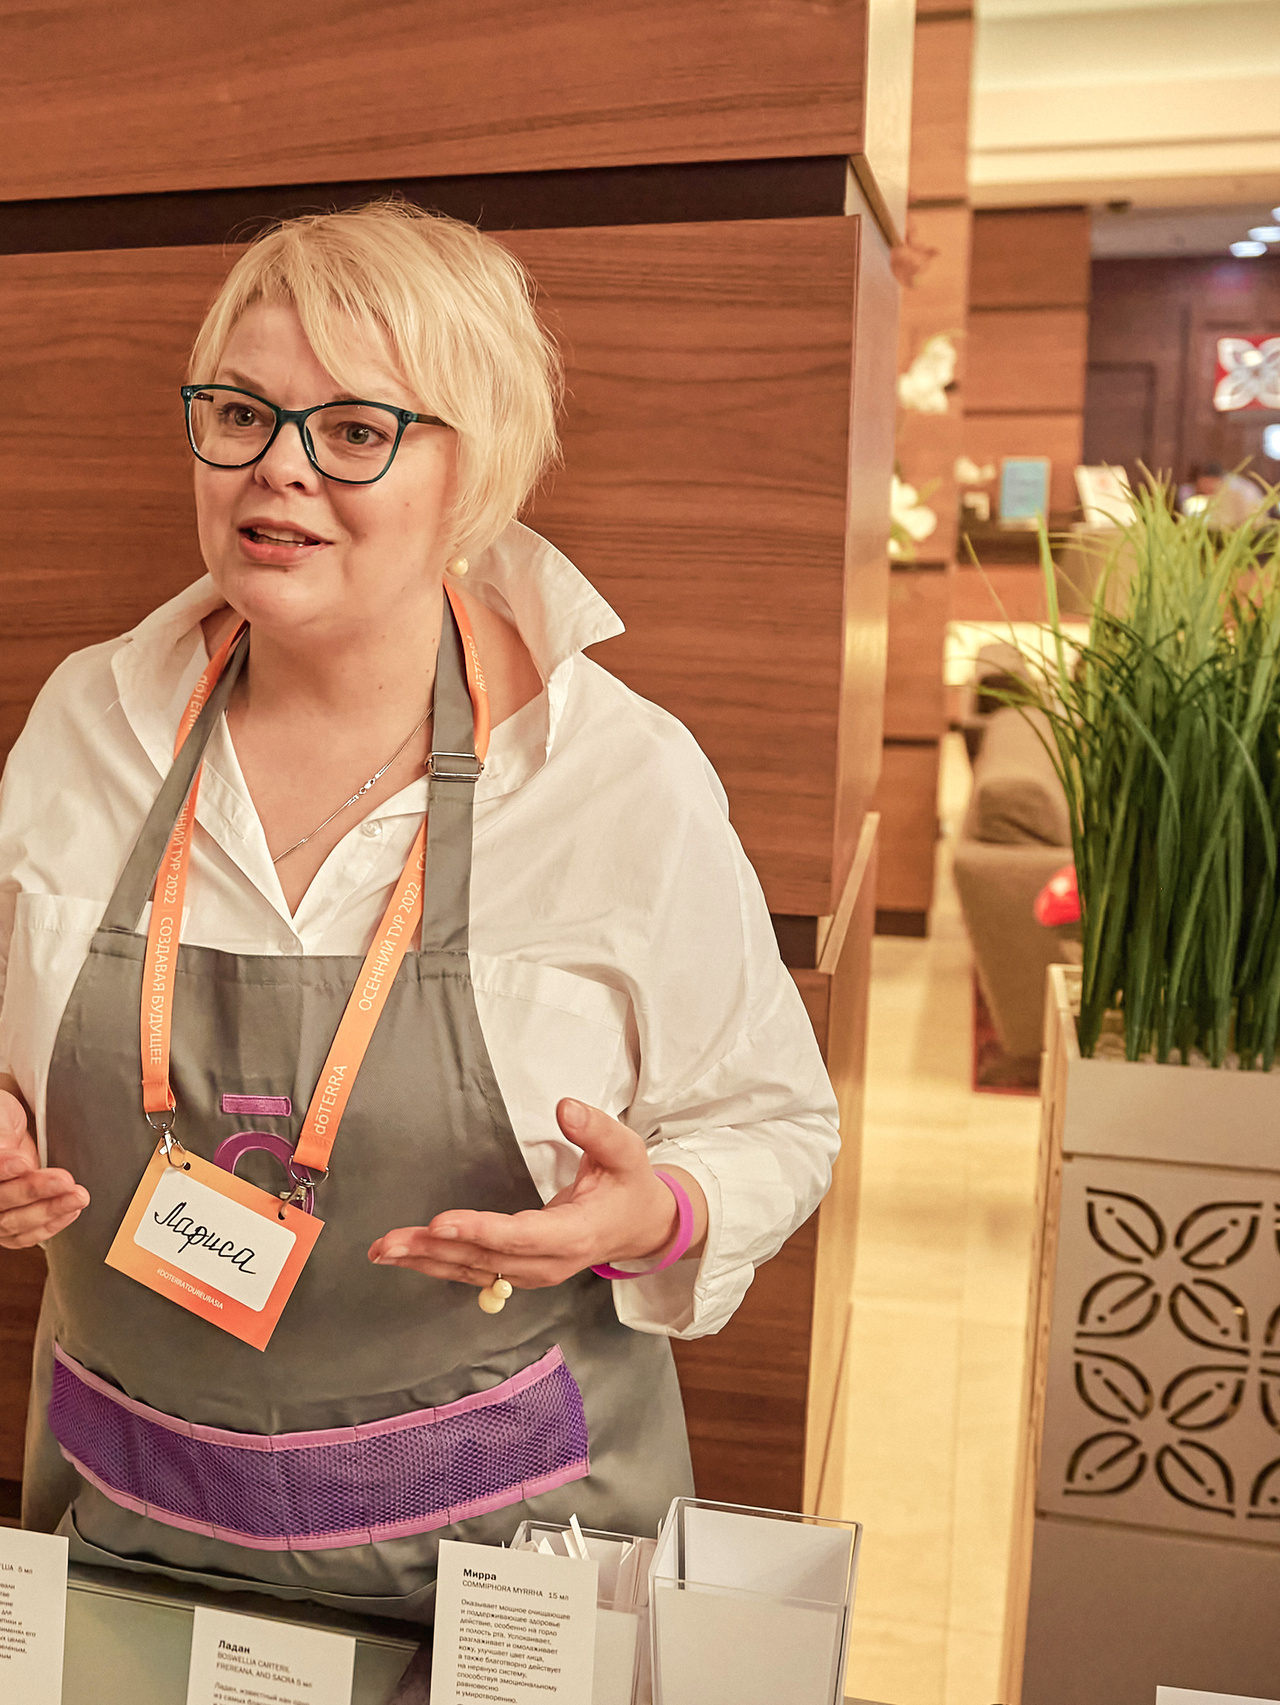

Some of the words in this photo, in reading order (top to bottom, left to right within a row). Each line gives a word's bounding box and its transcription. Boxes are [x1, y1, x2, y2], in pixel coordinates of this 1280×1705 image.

[170, 850, 182, 871] ТУР
[164, 875, 178, 904] 2022
[152, 916, 174, 992] СОЗДАВАЯ
[358, 936, 397, 1012] ОСЕННИЙ
[386, 914, 407, 937] ТУР
[398, 882, 422, 914] 2022
[148, 993, 166, 1065] БУДУЩЕЕ
[314, 1064, 348, 1135] dōTERRA
[154, 1202, 256, 1275] Лариса
[157, 1268, 223, 1310] #DOTERRATOUREURASIA
[464, 1569, 496, 1580] Мирра
[219, 1640, 250, 1654] Ладан
[256, 1670, 270, 1679] AND
[296, 1678, 301, 1687] 5
